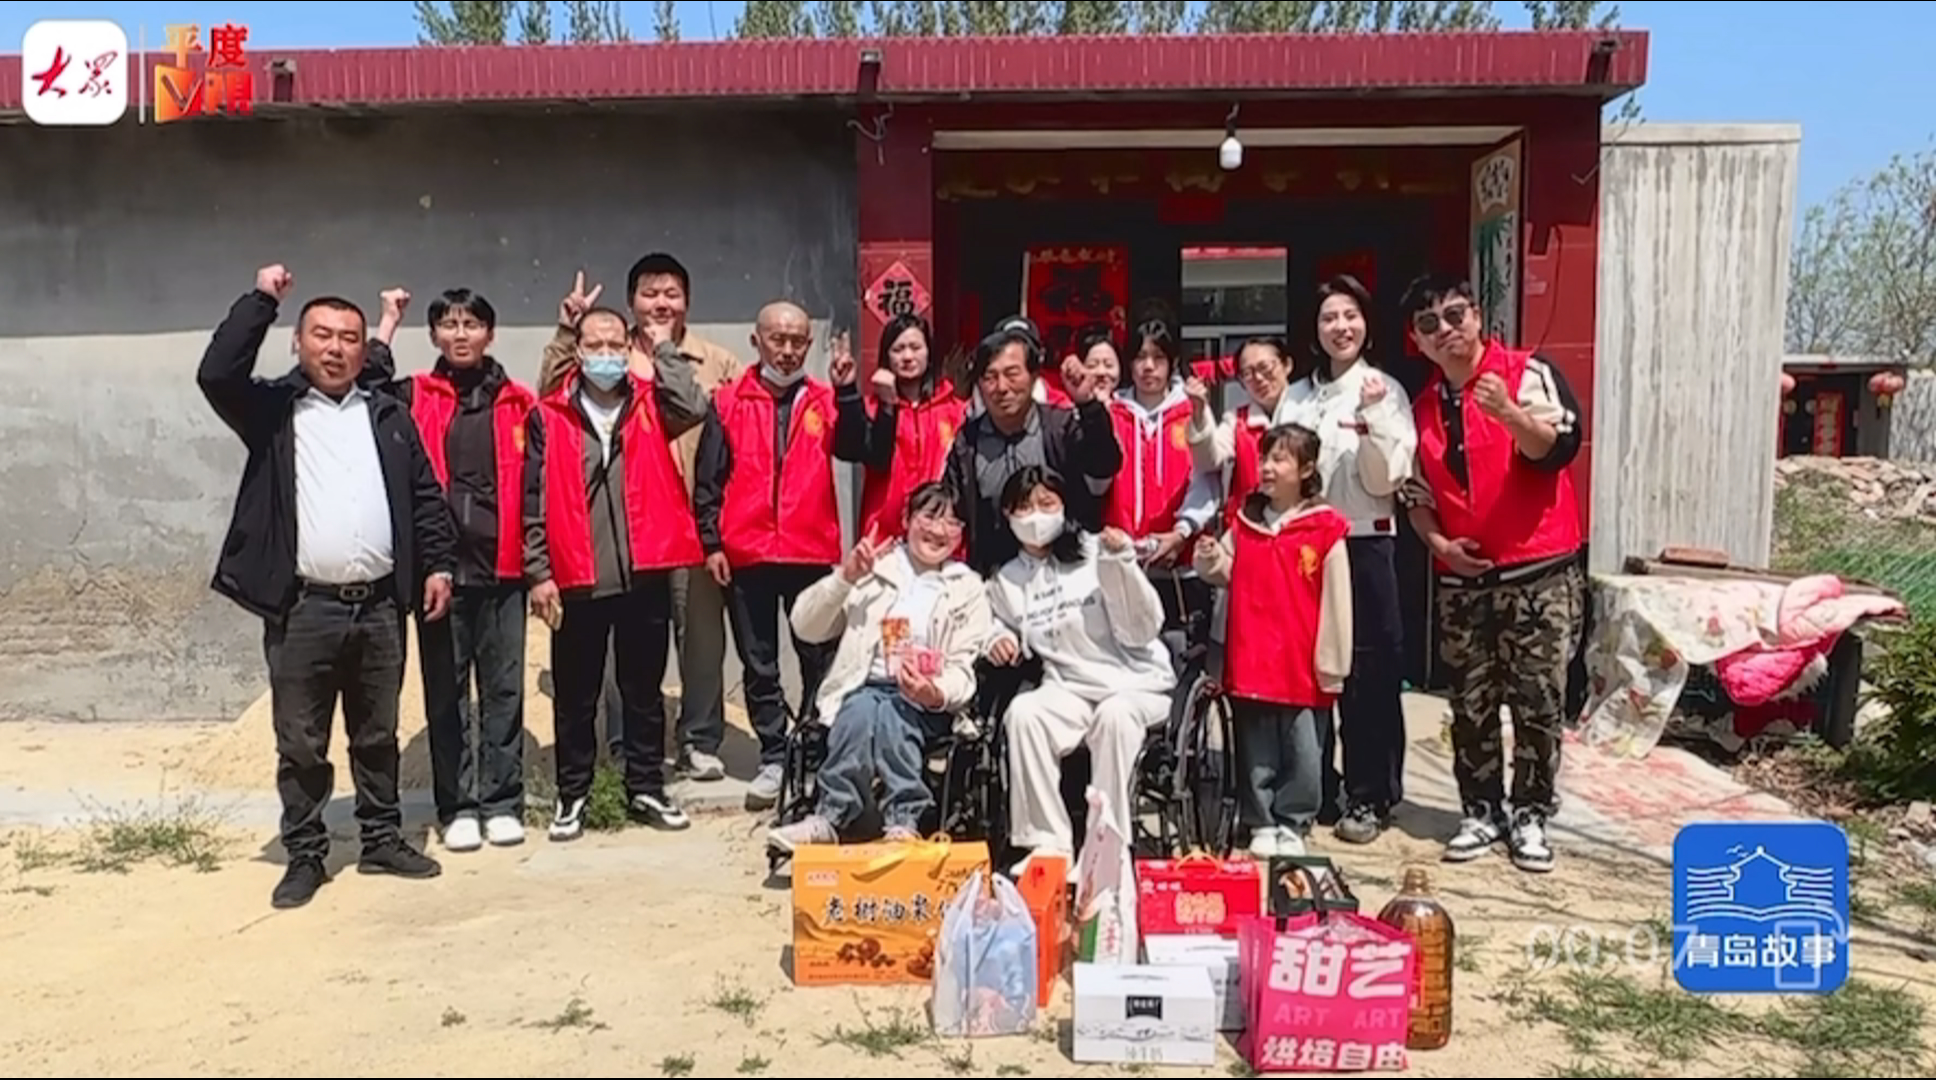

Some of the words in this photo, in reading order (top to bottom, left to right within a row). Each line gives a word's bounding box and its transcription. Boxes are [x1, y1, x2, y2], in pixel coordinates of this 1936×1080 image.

[877, 278, 915, 318] 福
[1268, 936, 1412, 999] 甜艺
[1274, 1003, 1331, 1027] ART
[1352, 1007, 1402, 1029] ART
[1260, 1034, 1408, 1070] 烘焙自由
